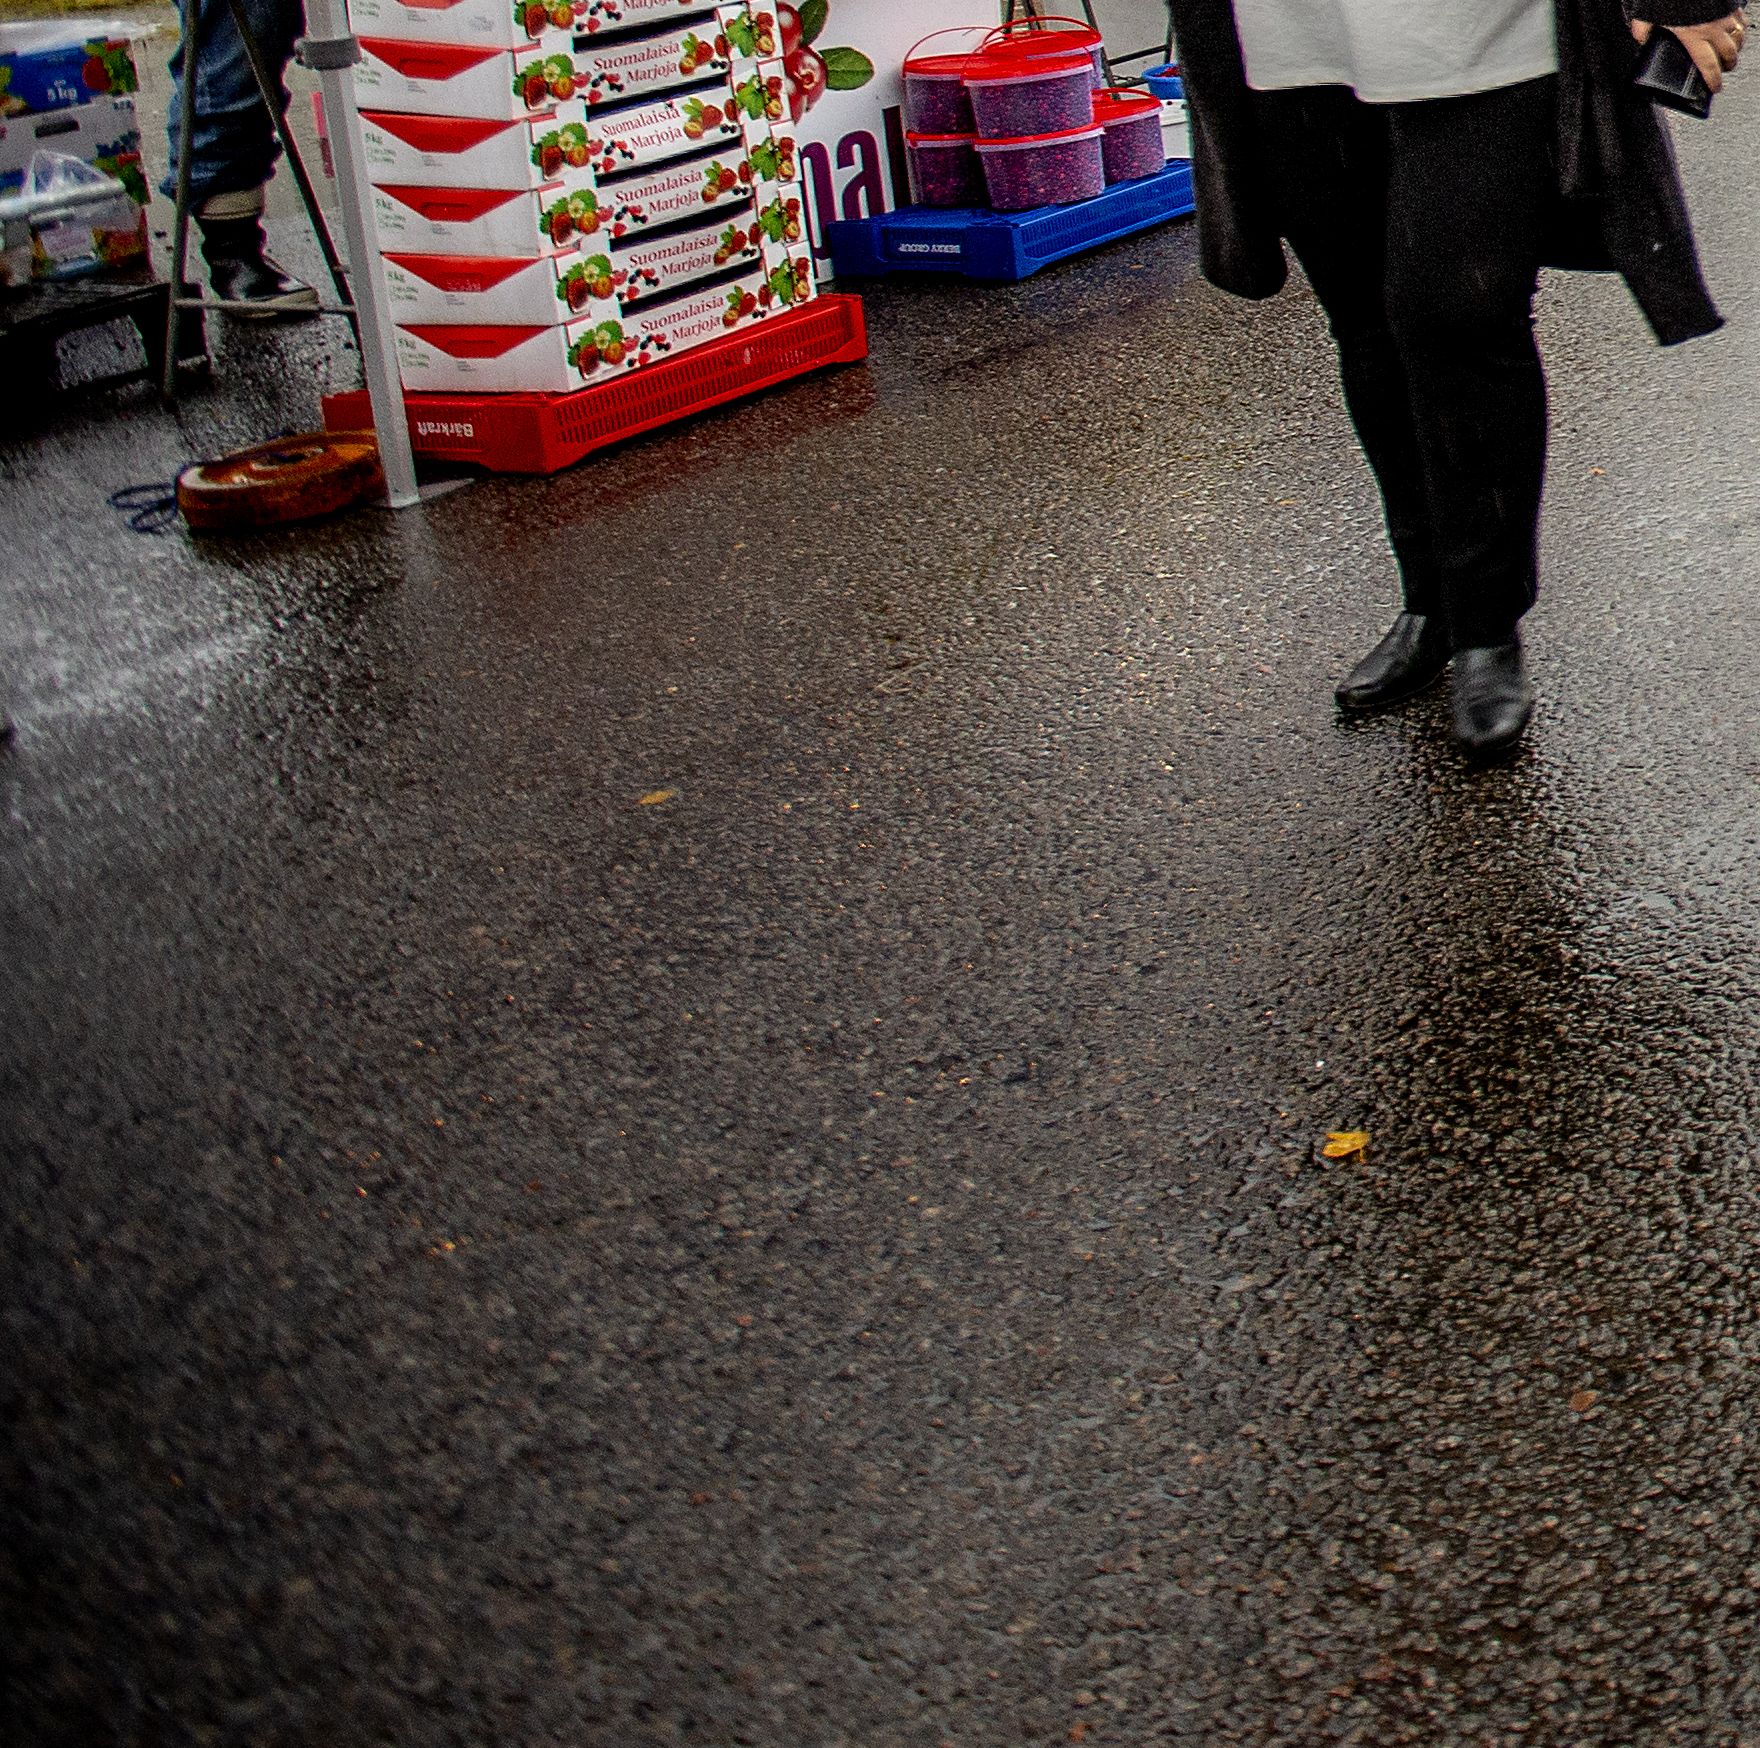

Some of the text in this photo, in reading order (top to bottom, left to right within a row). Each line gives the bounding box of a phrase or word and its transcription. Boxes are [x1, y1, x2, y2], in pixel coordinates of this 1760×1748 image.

[594, 41, 680, 72] Suomalaisia
[626, 61, 677, 83] Marjoja
[602, 108, 681, 138] Suomalaisia
[630, 126, 682, 149] Marjoja
[615, 170, 702, 204] Suomalaisia
[650, 190, 699, 214] Marjoja
[629, 234, 718, 268] Suomalaisia
[662, 254, 712, 277] Marjoja
[640, 295, 724, 334] Suomalaisia
[672, 316, 721, 341] Marjoja
